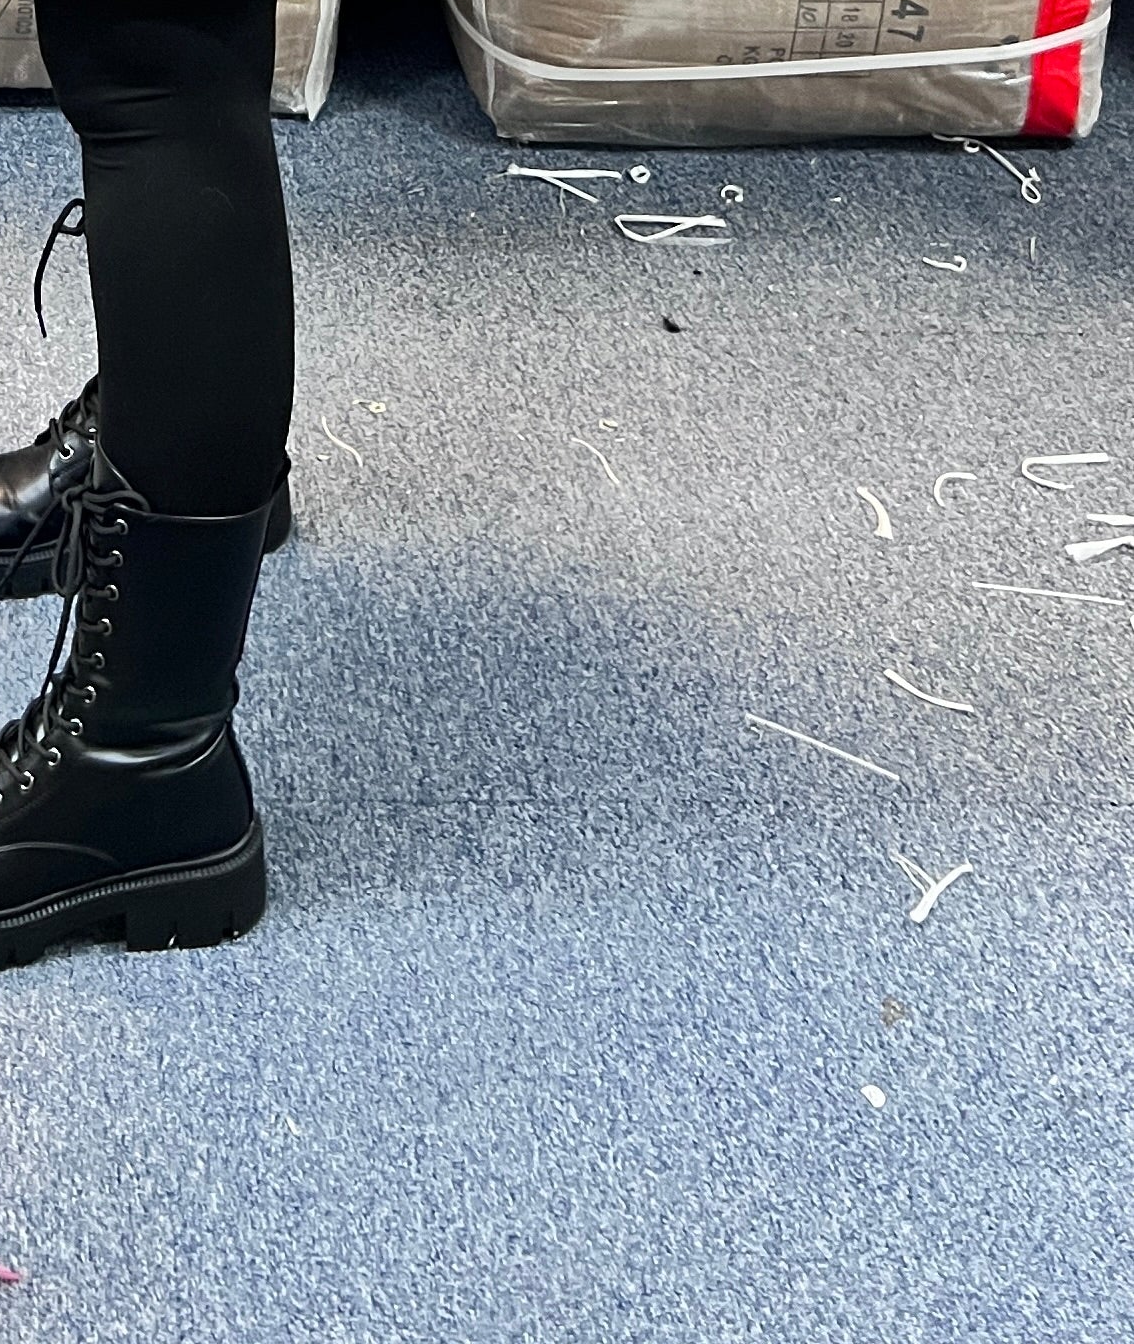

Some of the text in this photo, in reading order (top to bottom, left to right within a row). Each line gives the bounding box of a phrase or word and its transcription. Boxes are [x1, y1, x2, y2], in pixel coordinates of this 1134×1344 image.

[800, 4, 818, 24] 10
[841, 6, 859, 23] 18
[835, 31, 857, 50] 20
